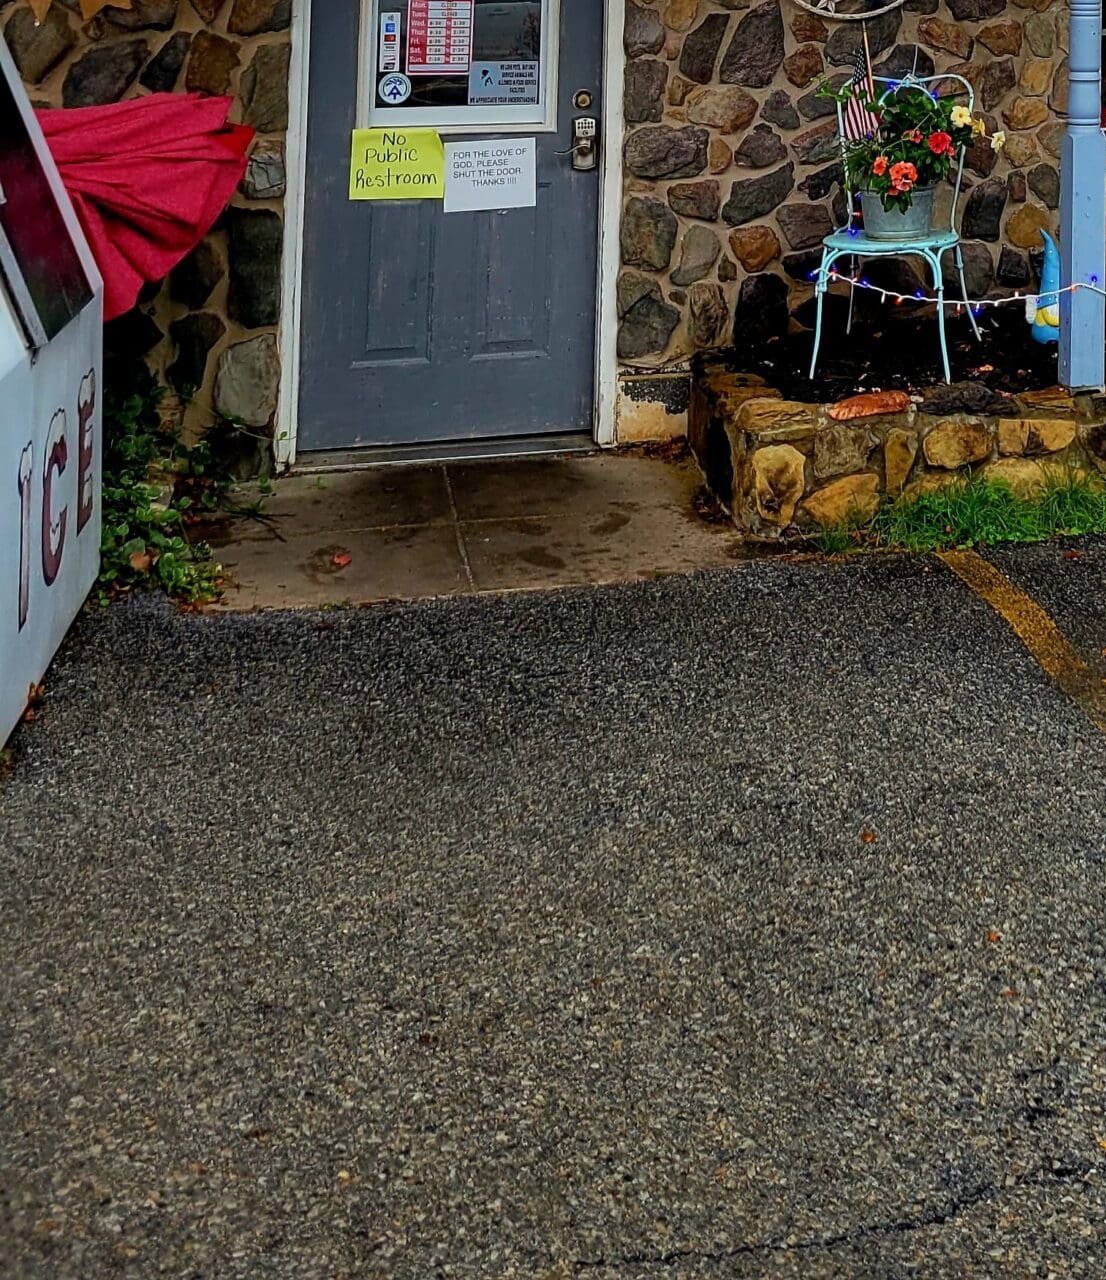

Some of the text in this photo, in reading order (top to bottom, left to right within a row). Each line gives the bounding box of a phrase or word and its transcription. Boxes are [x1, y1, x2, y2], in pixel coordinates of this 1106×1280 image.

[382, 131, 406, 146] No
[365, 148, 419, 164] Public
[453, 147, 528, 160] FOR THE LOVE OF
[476, 159, 509, 168] PLEASE
[355, 167, 437, 189] Restroom
[453, 170, 476, 179] SHUT
[478, 169, 495, 177] THE
[472, 178, 505, 187] THANKS
[18, 367, 95, 634] ICE
